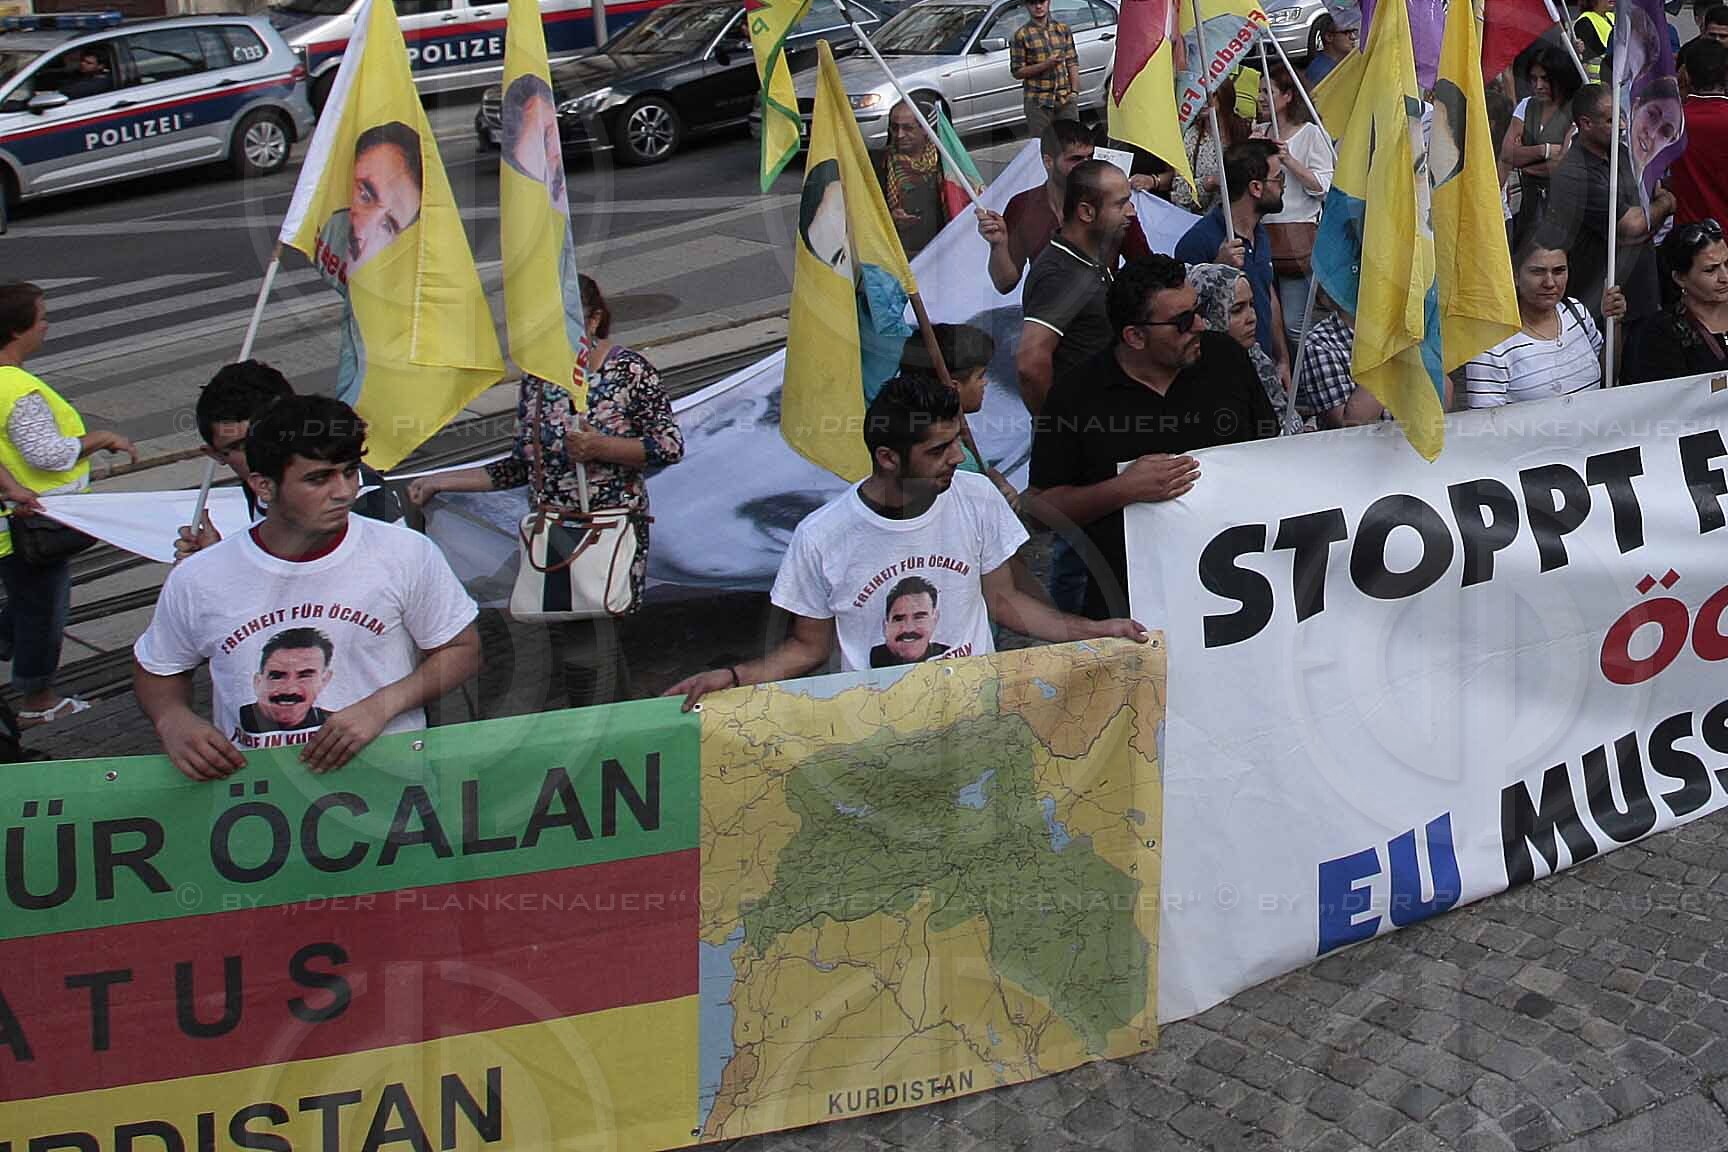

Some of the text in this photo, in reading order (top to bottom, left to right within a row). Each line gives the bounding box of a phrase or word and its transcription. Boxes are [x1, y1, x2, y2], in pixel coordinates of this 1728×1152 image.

[240, 44, 263, 61] 133
[404, 36, 502, 64] POLIZE
[85, 114, 182, 150] POLIZEI
[1198, 446, 1644, 649] STOPPT
[853, 554, 971, 608] FREIHEIT FÜR ÖCALAN
[221, 603, 387, 655] FREIHEIT FÜR ÖCALAN
[209, 752, 662, 886] ÖCALAN
[1317, 811, 1462, 956] EU
[827, 1069, 974, 1115] KURDISTAN
